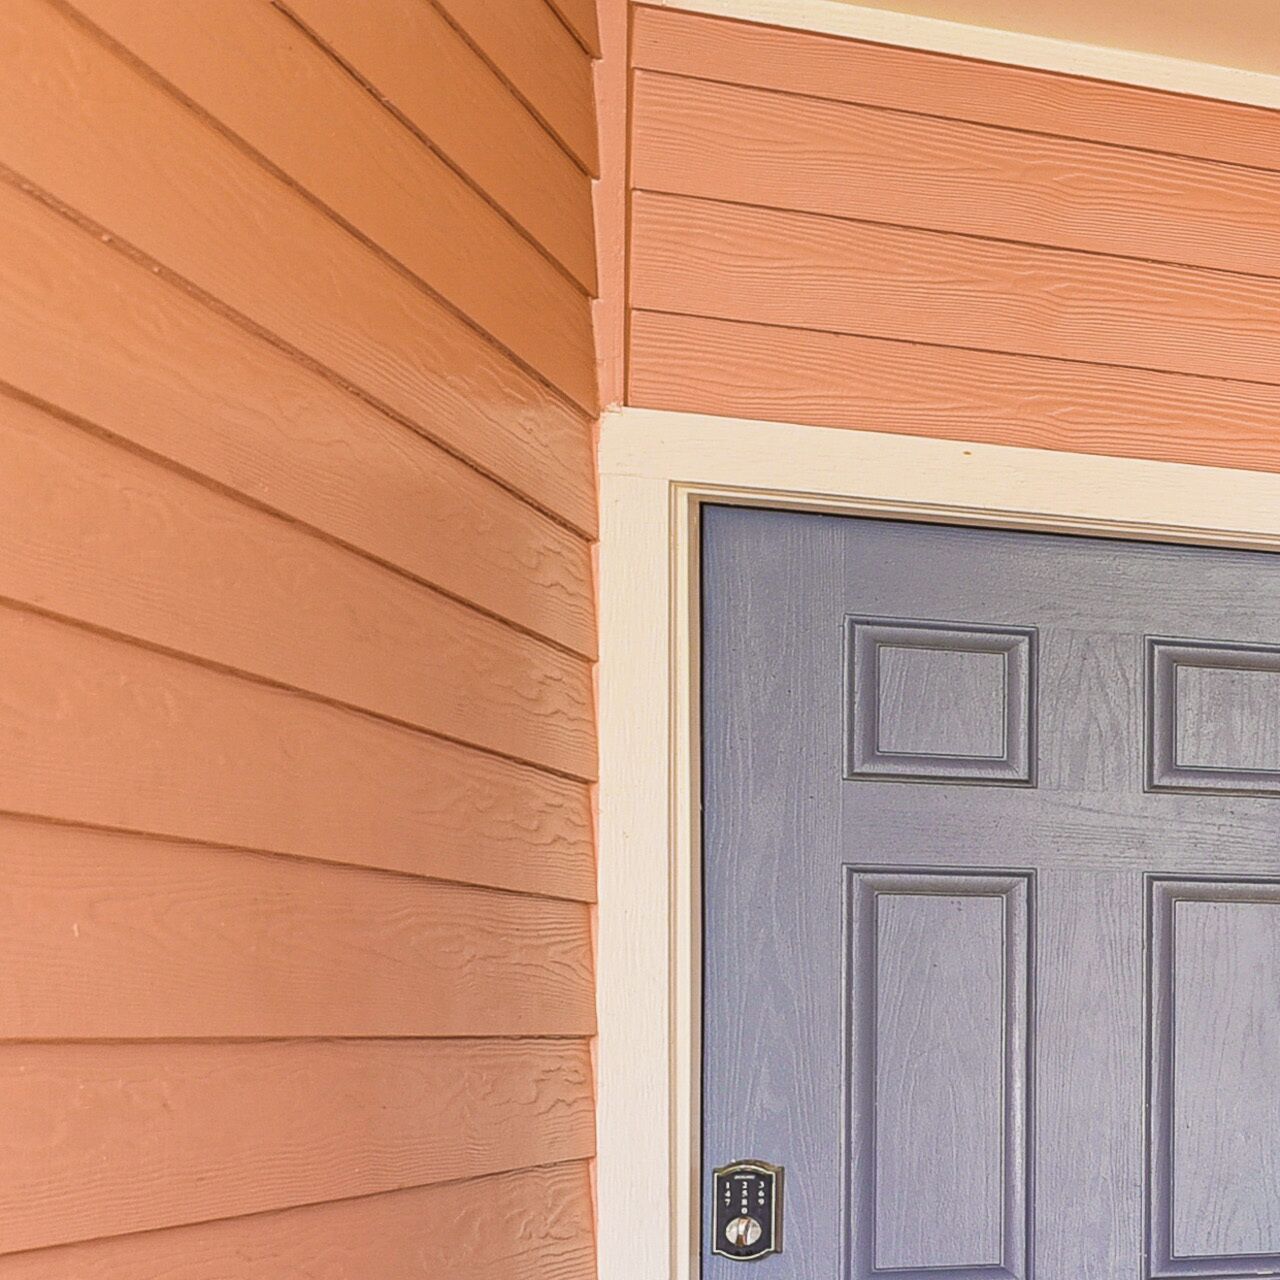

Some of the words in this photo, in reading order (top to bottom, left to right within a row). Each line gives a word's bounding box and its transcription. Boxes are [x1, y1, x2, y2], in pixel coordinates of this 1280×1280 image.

[742, 1181, 748, 1189] 2
[758, 1181, 765, 1189] 3
[724, 1198, 731, 1206] 7
[741, 1198, 748, 1206] 8
[758, 1198, 765, 1206] 9
